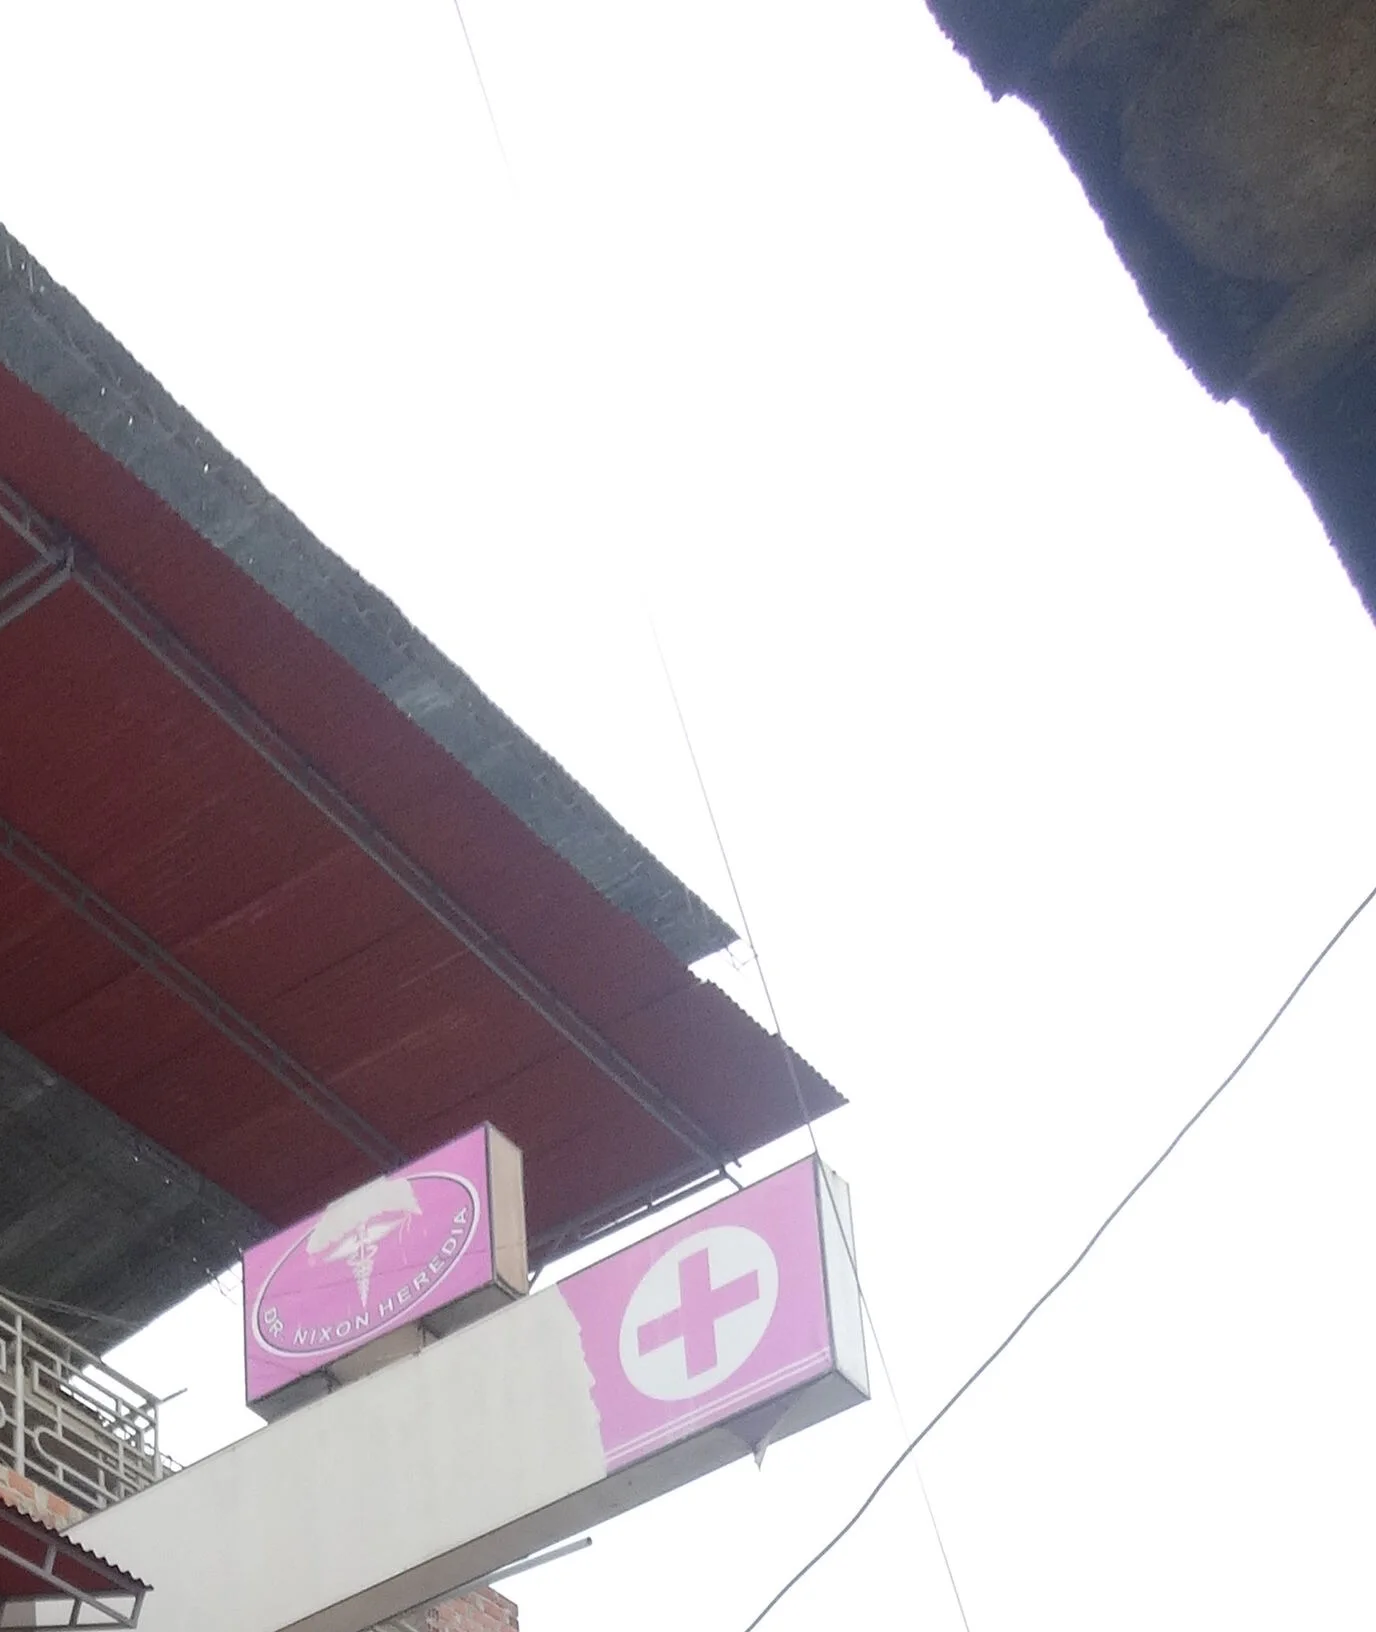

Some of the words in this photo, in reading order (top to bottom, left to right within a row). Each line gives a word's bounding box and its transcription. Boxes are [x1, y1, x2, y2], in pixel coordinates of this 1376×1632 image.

[261, 1308, 285, 1341] DR.
[293, 1311, 370, 1345] NIXON
[378, 1206, 468, 1317] HEREDIA
